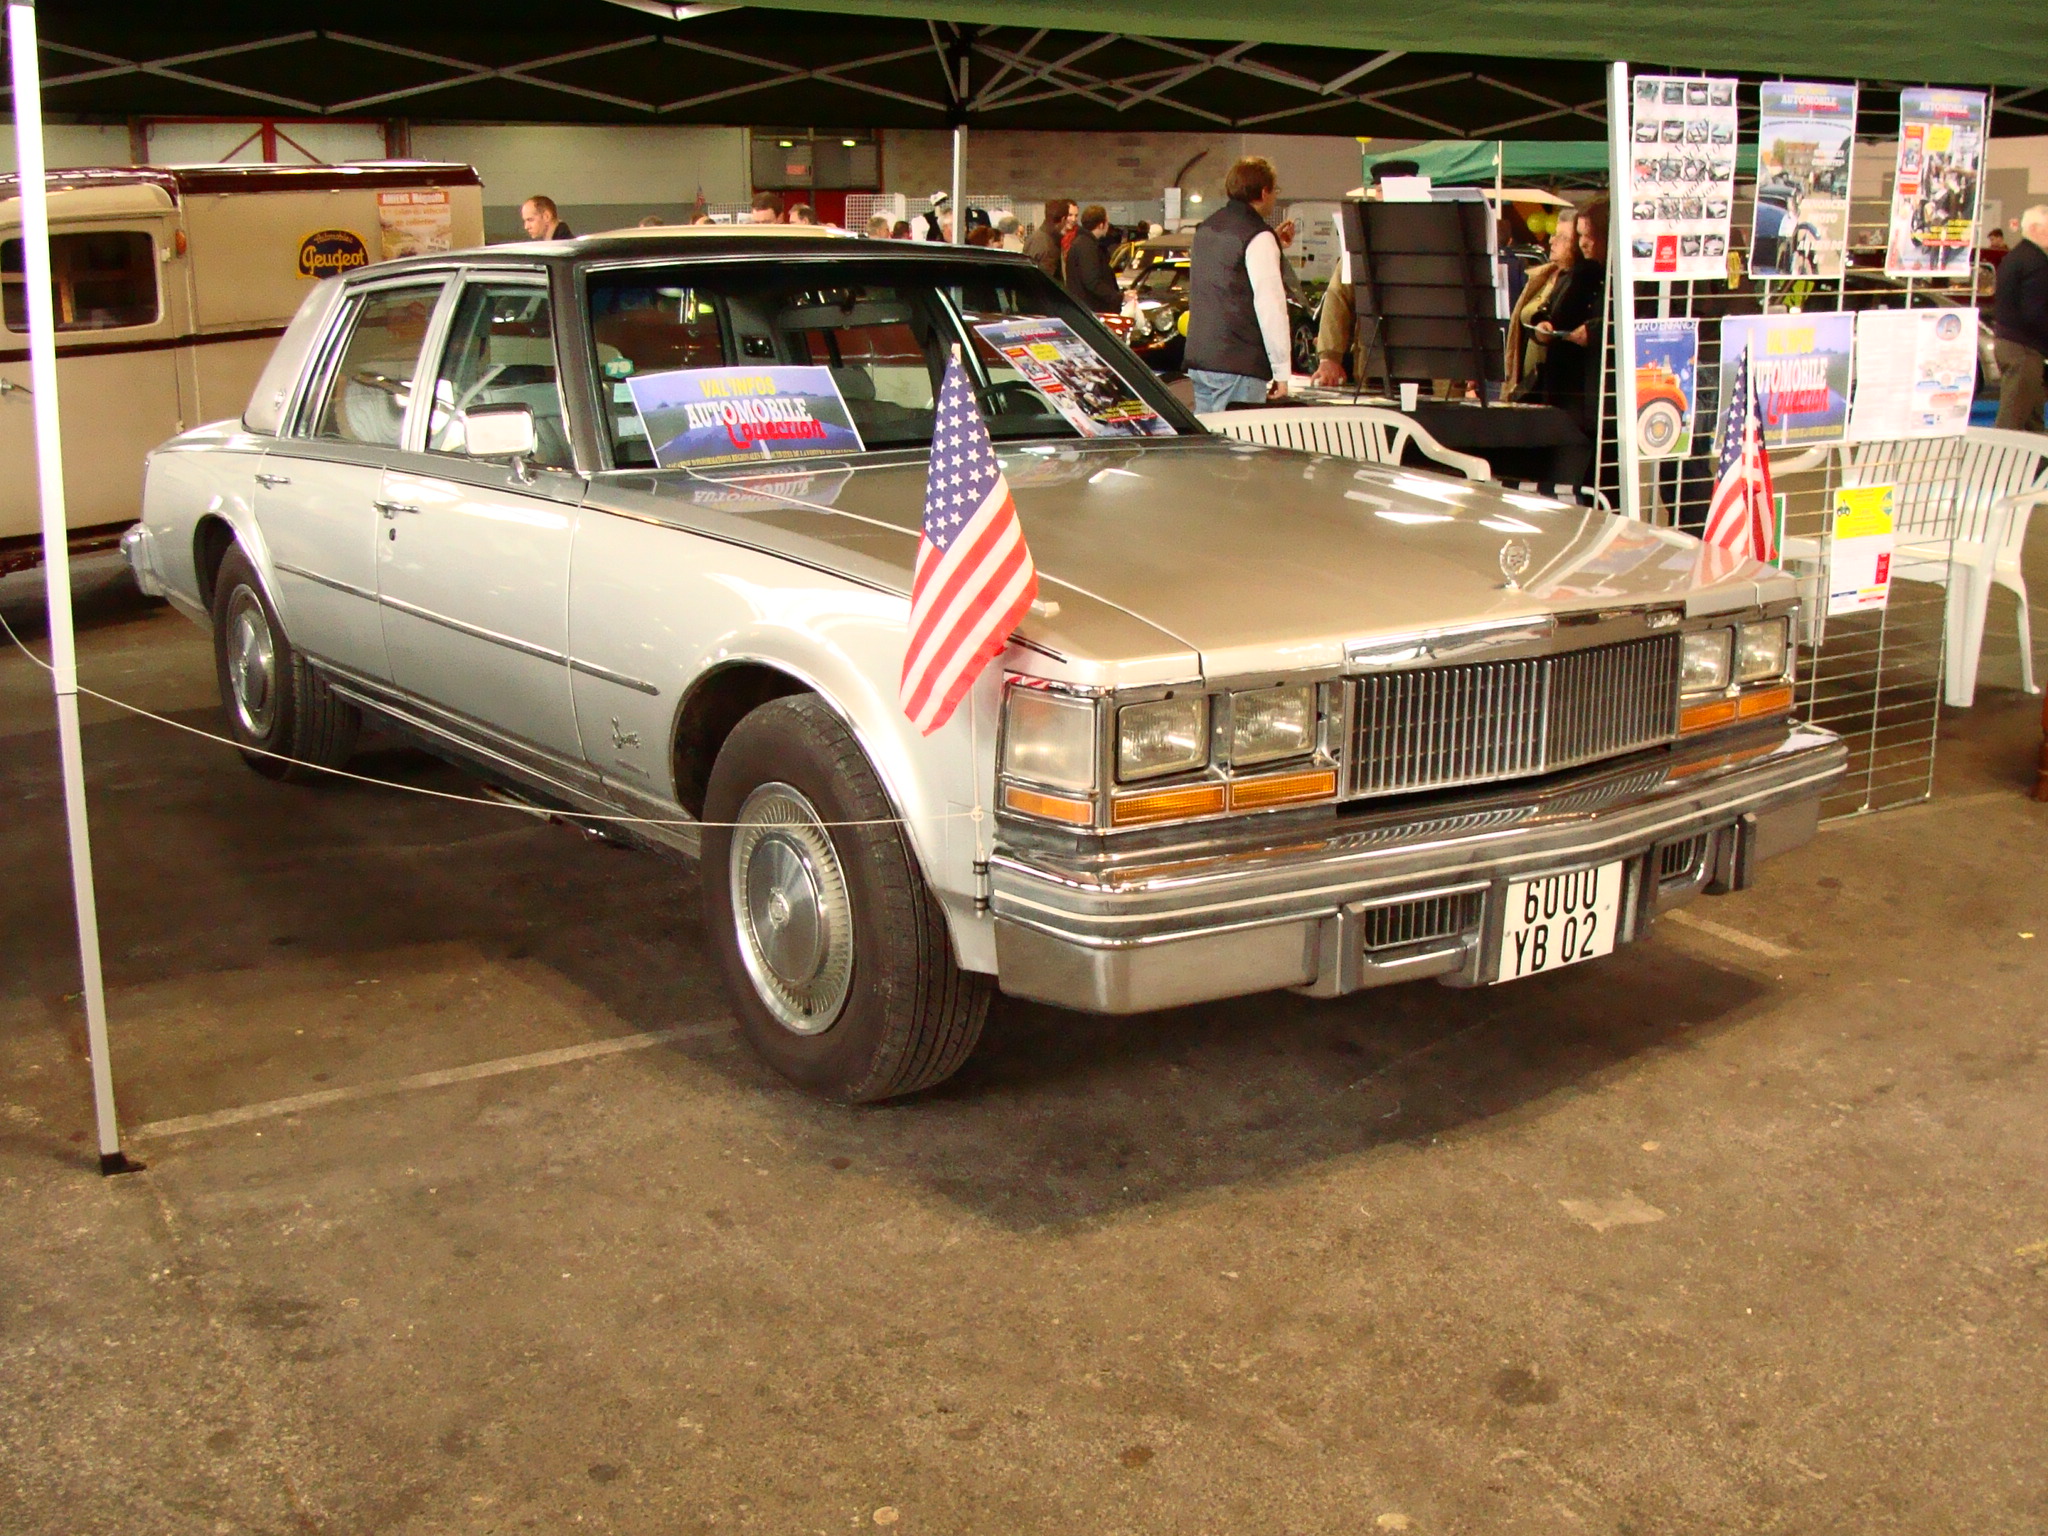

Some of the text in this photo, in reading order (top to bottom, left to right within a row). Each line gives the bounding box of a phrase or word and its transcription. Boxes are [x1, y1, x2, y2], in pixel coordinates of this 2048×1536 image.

[1781, 94, 1837, 106] AUTOMOBILE
[302, 245, 365, 275] Peugeot
[1754, 358, 1828, 394] UTOMOBILE
[684, 398, 813, 429] AUTOMOBILE
[723, 410, 827, 449] Collection
[1524, 868, 1599, 925] 6000
[1514, 911, 1597, 977] YB 02
